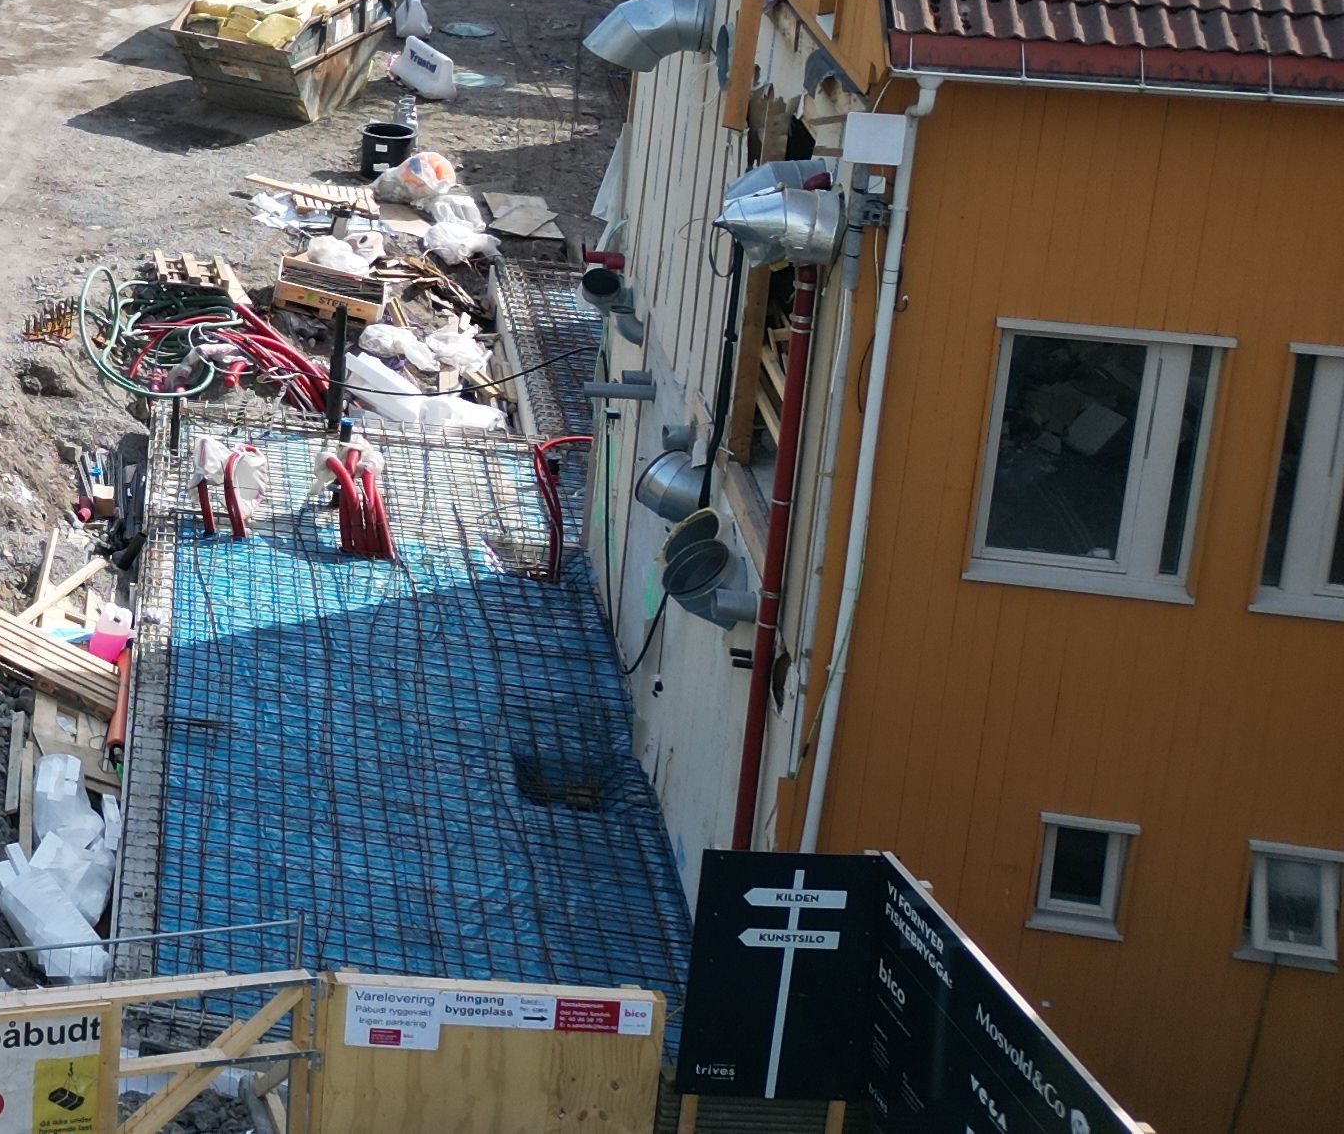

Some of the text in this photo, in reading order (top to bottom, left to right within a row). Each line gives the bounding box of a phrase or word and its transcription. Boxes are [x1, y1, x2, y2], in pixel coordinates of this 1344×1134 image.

[775, 892, 820, 903] KILDEN
[887, 880, 944, 954] VI FORNYER
[758, 932, 826, 944] KUNSTSILO
[878, 958, 906, 1005] bico
[355, 991, 436, 1006] Varelevering
[456, 993, 505, 1006] Inngang
[444, 1004, 514, 1017] byggeplass
[624, 1009, 647, 1018] bico
